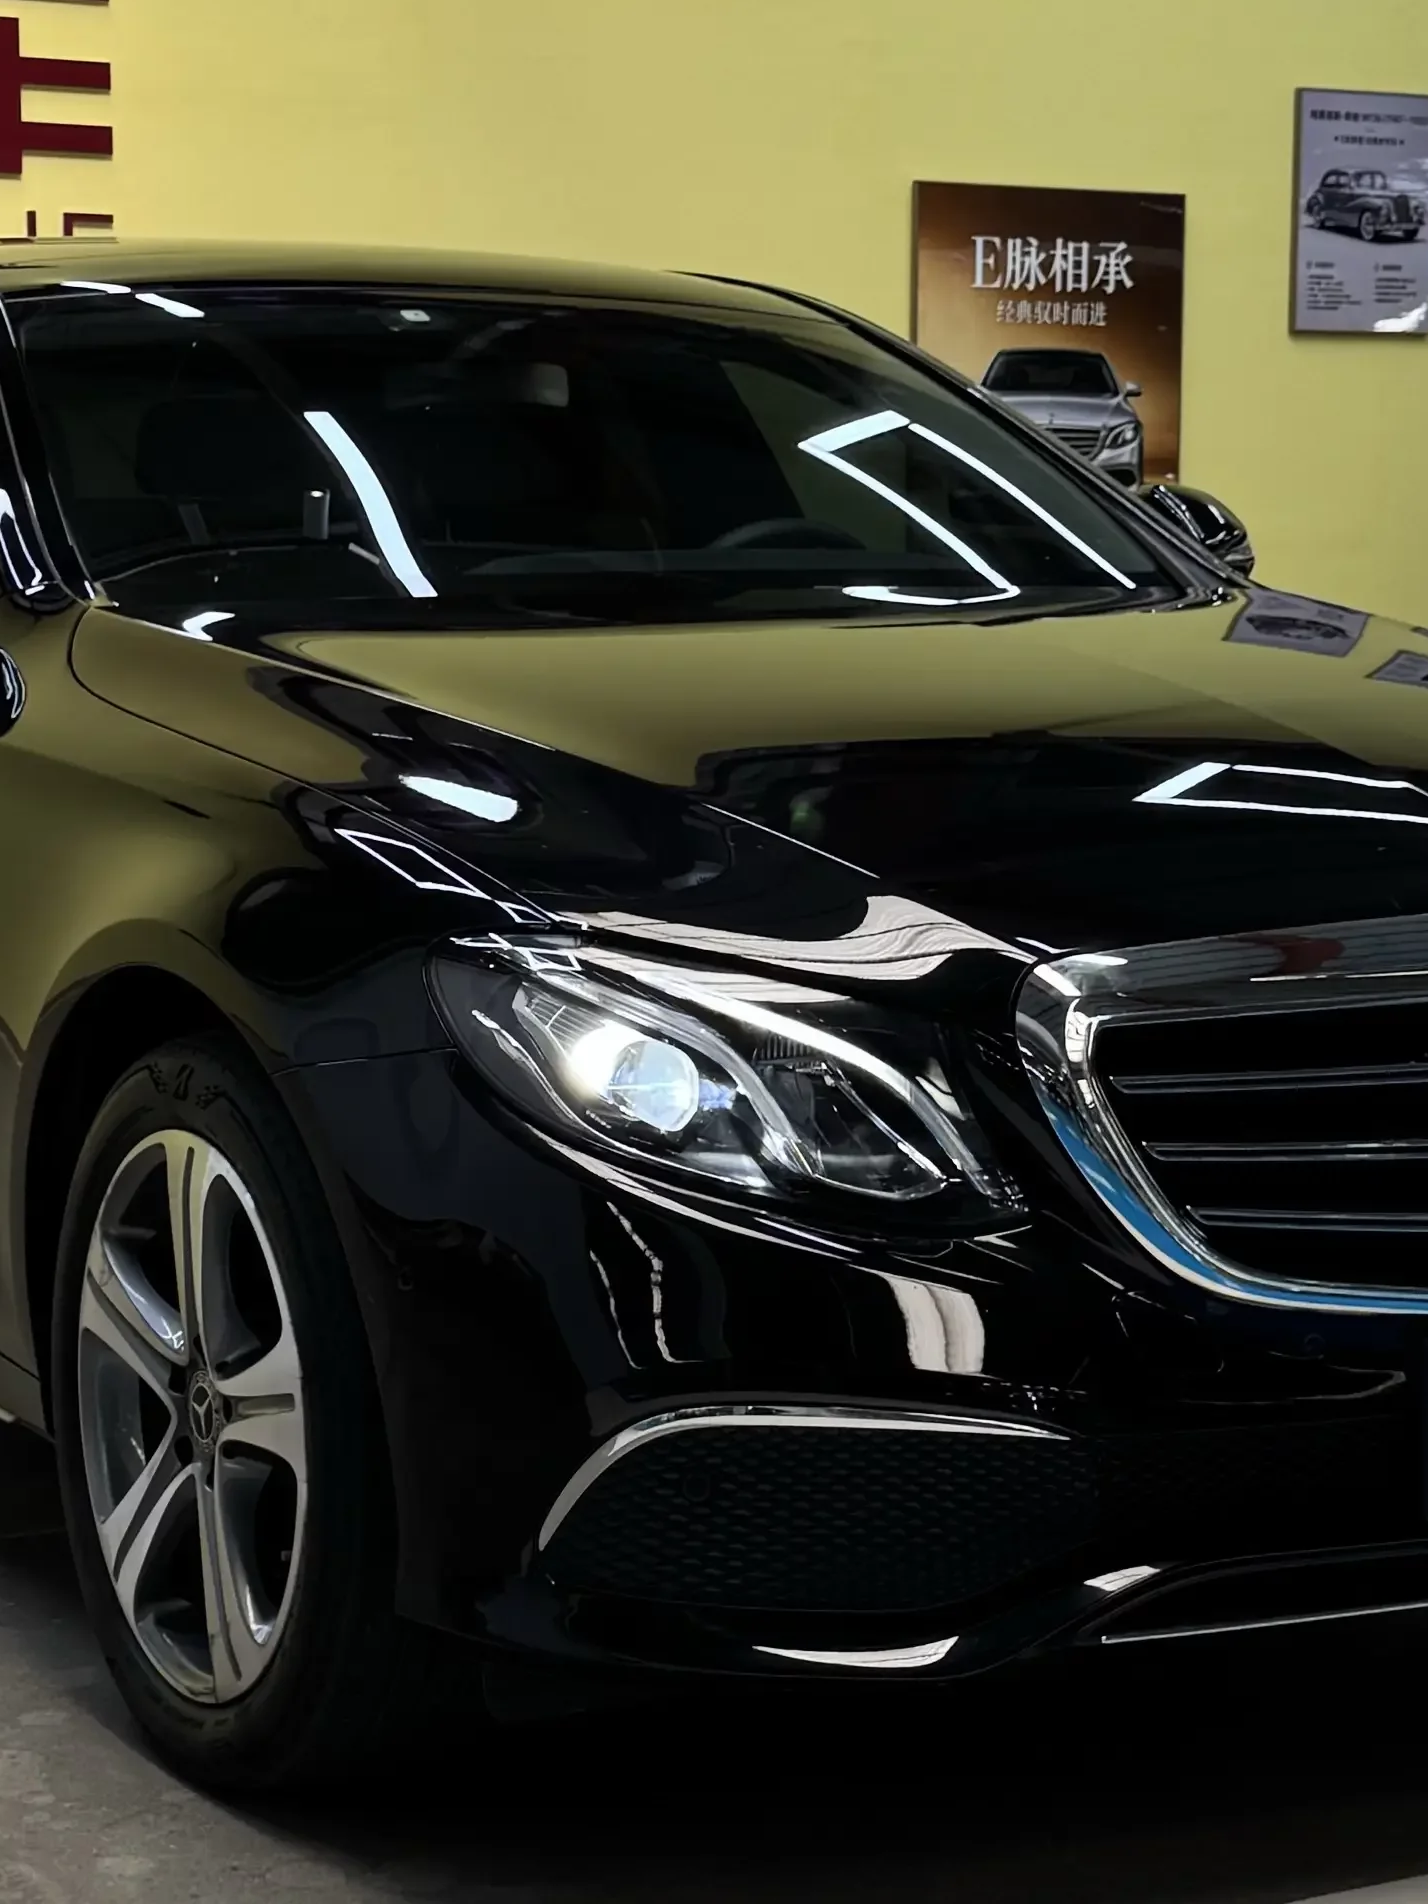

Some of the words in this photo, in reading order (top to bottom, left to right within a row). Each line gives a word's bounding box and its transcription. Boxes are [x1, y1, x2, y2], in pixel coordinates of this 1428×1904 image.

[970, 236, 1135, 294] E脉相承
[996, 299, 1107, 326] 经典驭时而进
